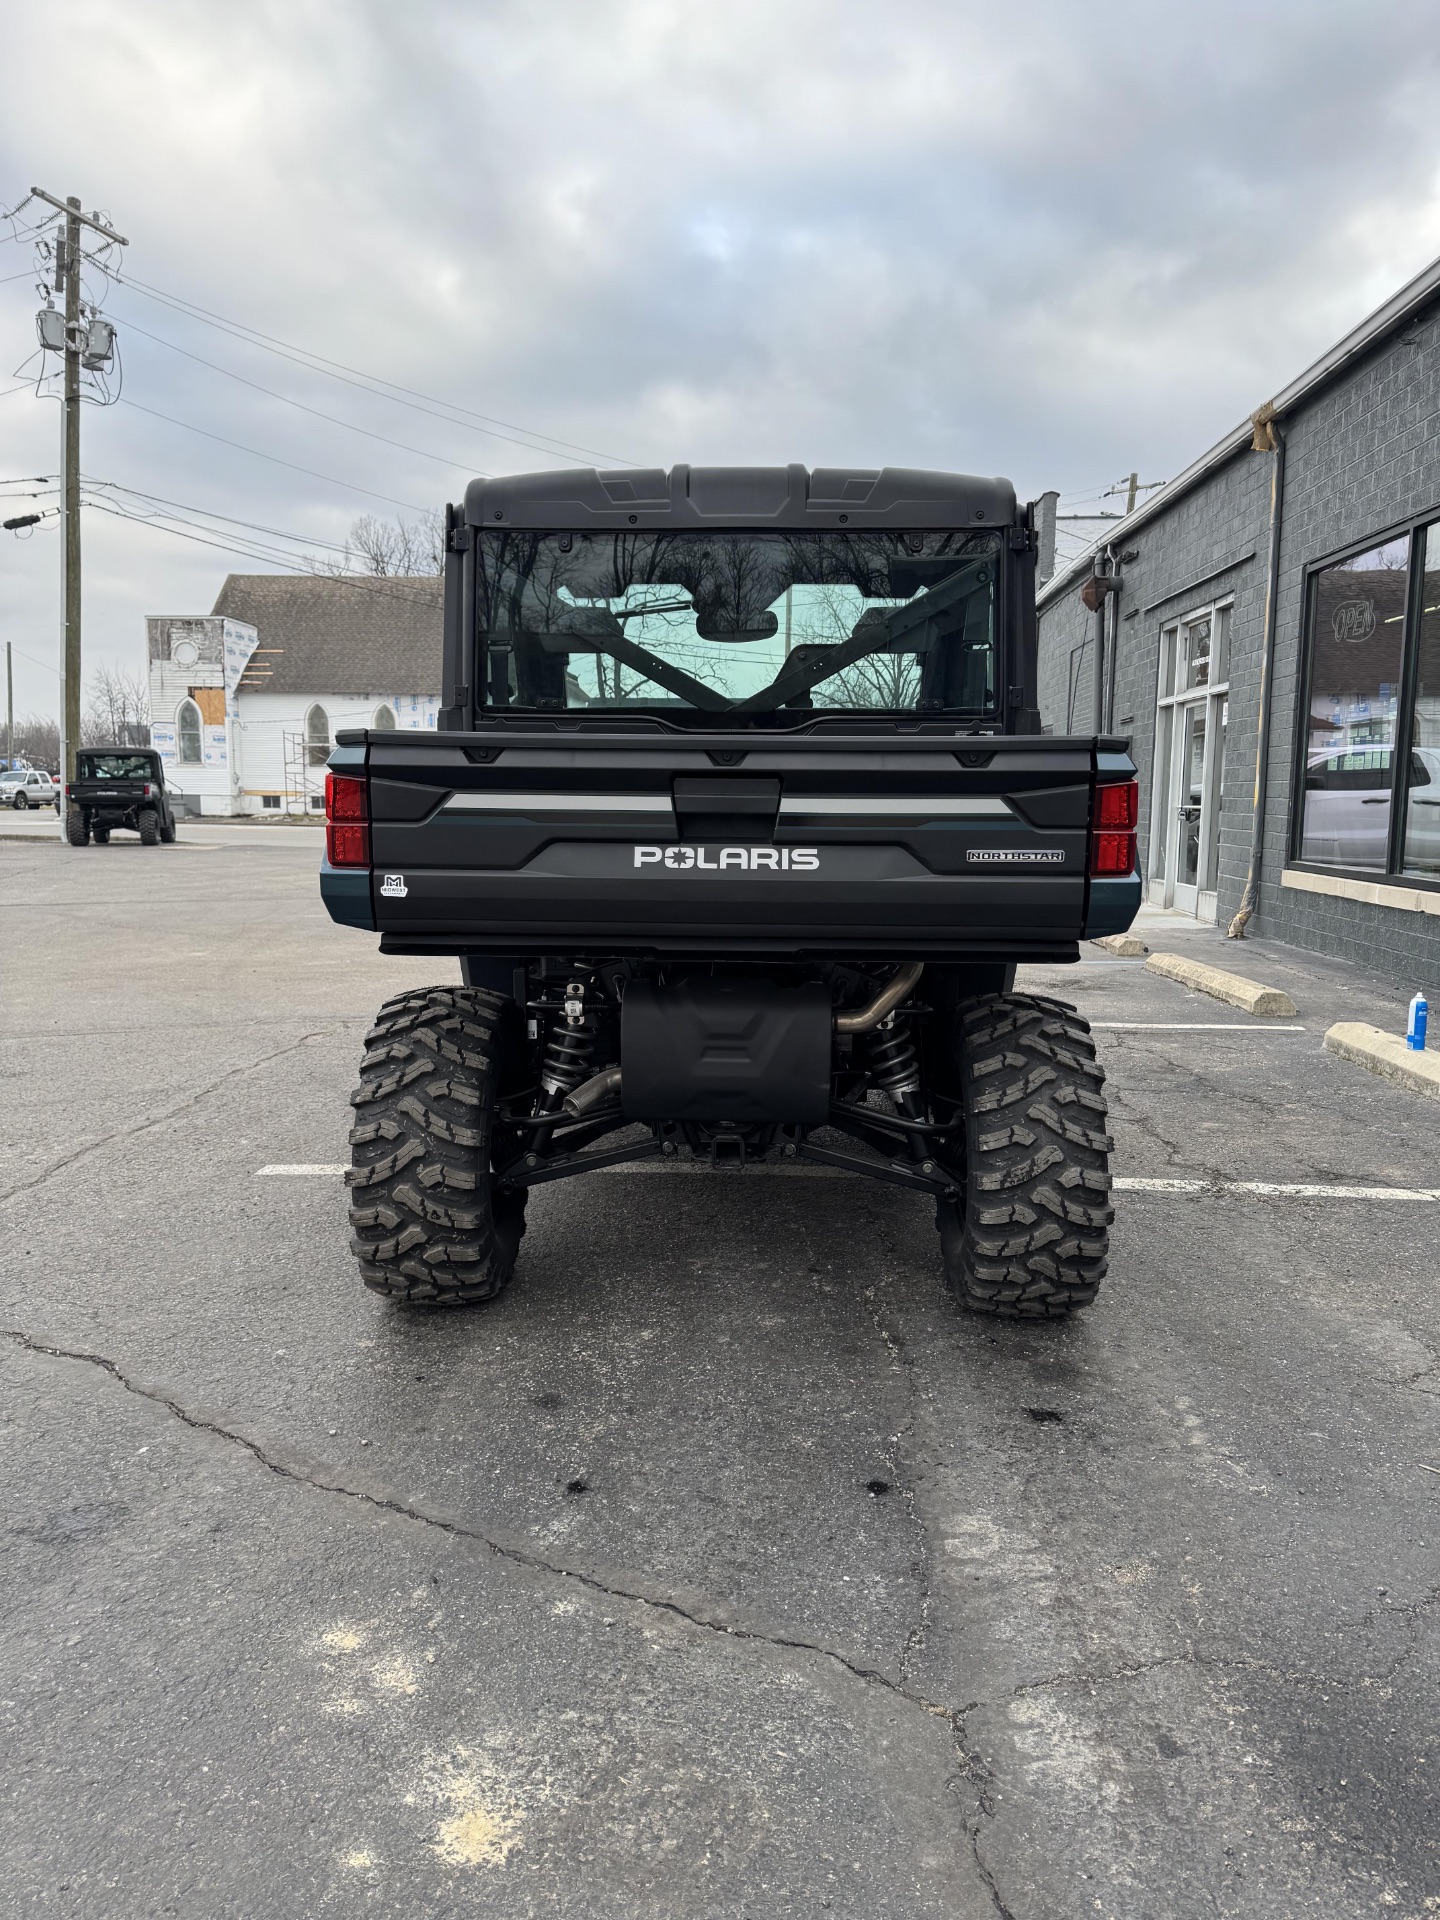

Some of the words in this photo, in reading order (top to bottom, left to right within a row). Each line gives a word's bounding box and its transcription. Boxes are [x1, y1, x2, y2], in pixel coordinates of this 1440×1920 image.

[1335, 600, 1374, 642] OPEN
[633, 846, 821, 870] POLARIS
[970, 852, 1061, 861] NORTHSTAR
